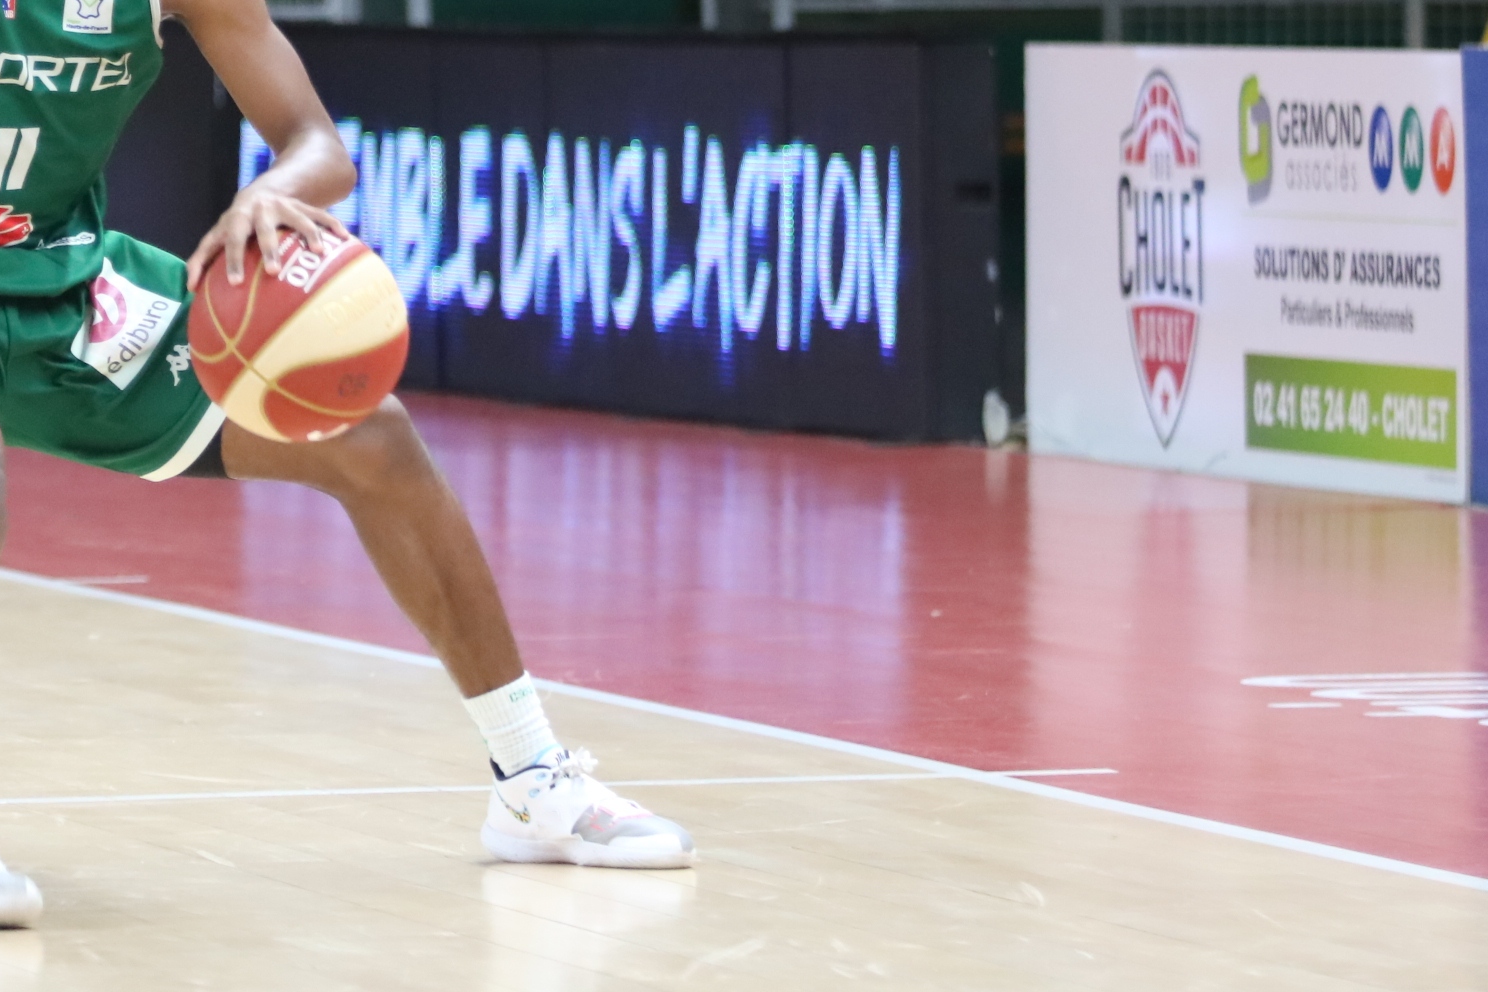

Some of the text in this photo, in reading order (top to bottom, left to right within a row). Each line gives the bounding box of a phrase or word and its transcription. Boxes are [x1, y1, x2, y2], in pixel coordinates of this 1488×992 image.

[1277, 102, 1362, 148] GERMOND
[1286, 154, 1358, 192] associés
[239, 118, 494, 316] EMBLE
[1118, 175, 1205, 306] CHOLET
[1254, 248, 1329, 281] SOLUTIONS
[1350, 253, 1441, 289] ASSURANCES
[106, 300, 169, 374] édiburo
[1281, 295, 1332, 327] Particuliers
[1345, 299, 1414, 333] Professionnels
[1253, 381, 1274, 427] 02
[1277, 383, 1296, 428] 41
[1300, 385, 1320, 431] 65
[1324, 387, 1344, 433] 24
[1348, 390, 1368, 435] 40
[1382, 393, 1449, 443] CHOLET
